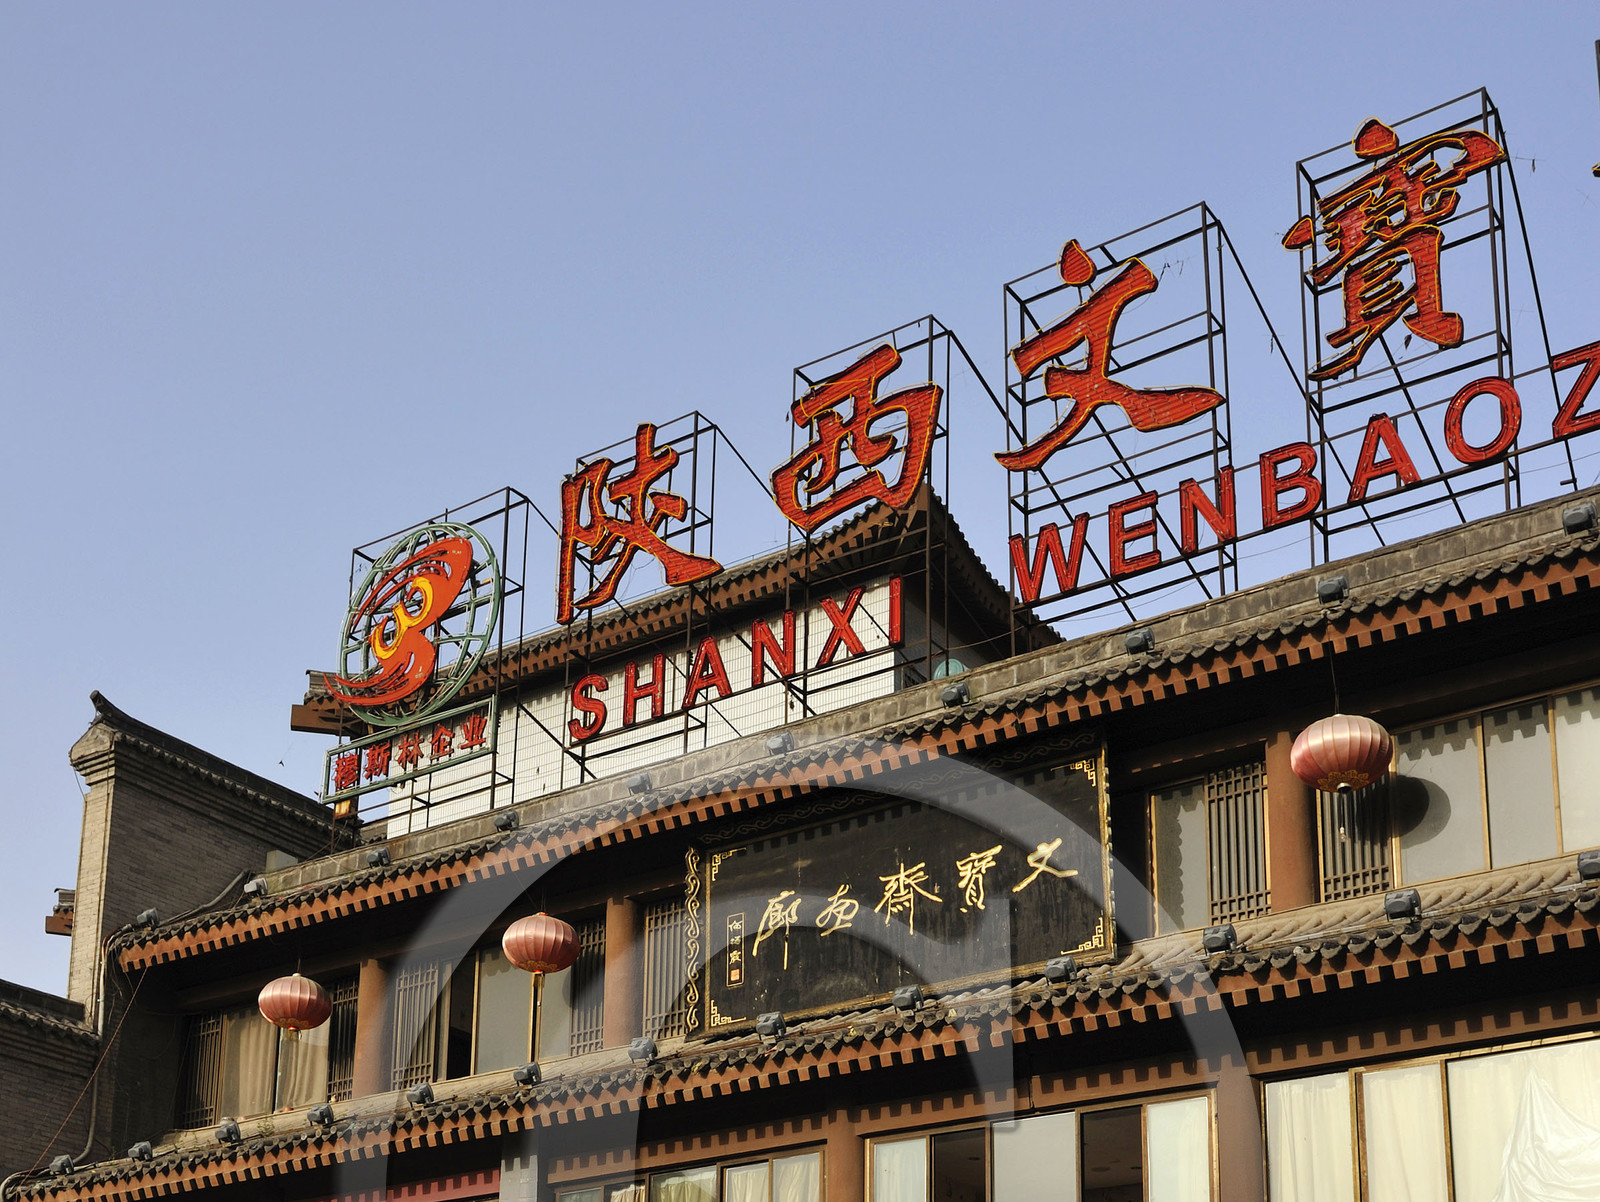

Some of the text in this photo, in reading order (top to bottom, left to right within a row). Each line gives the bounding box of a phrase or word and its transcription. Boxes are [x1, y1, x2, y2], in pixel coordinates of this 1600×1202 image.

[568, 341, 1600, 741] SHANXI WENBAOZ
[333, 714, 487, 789] 穆斯林企业
